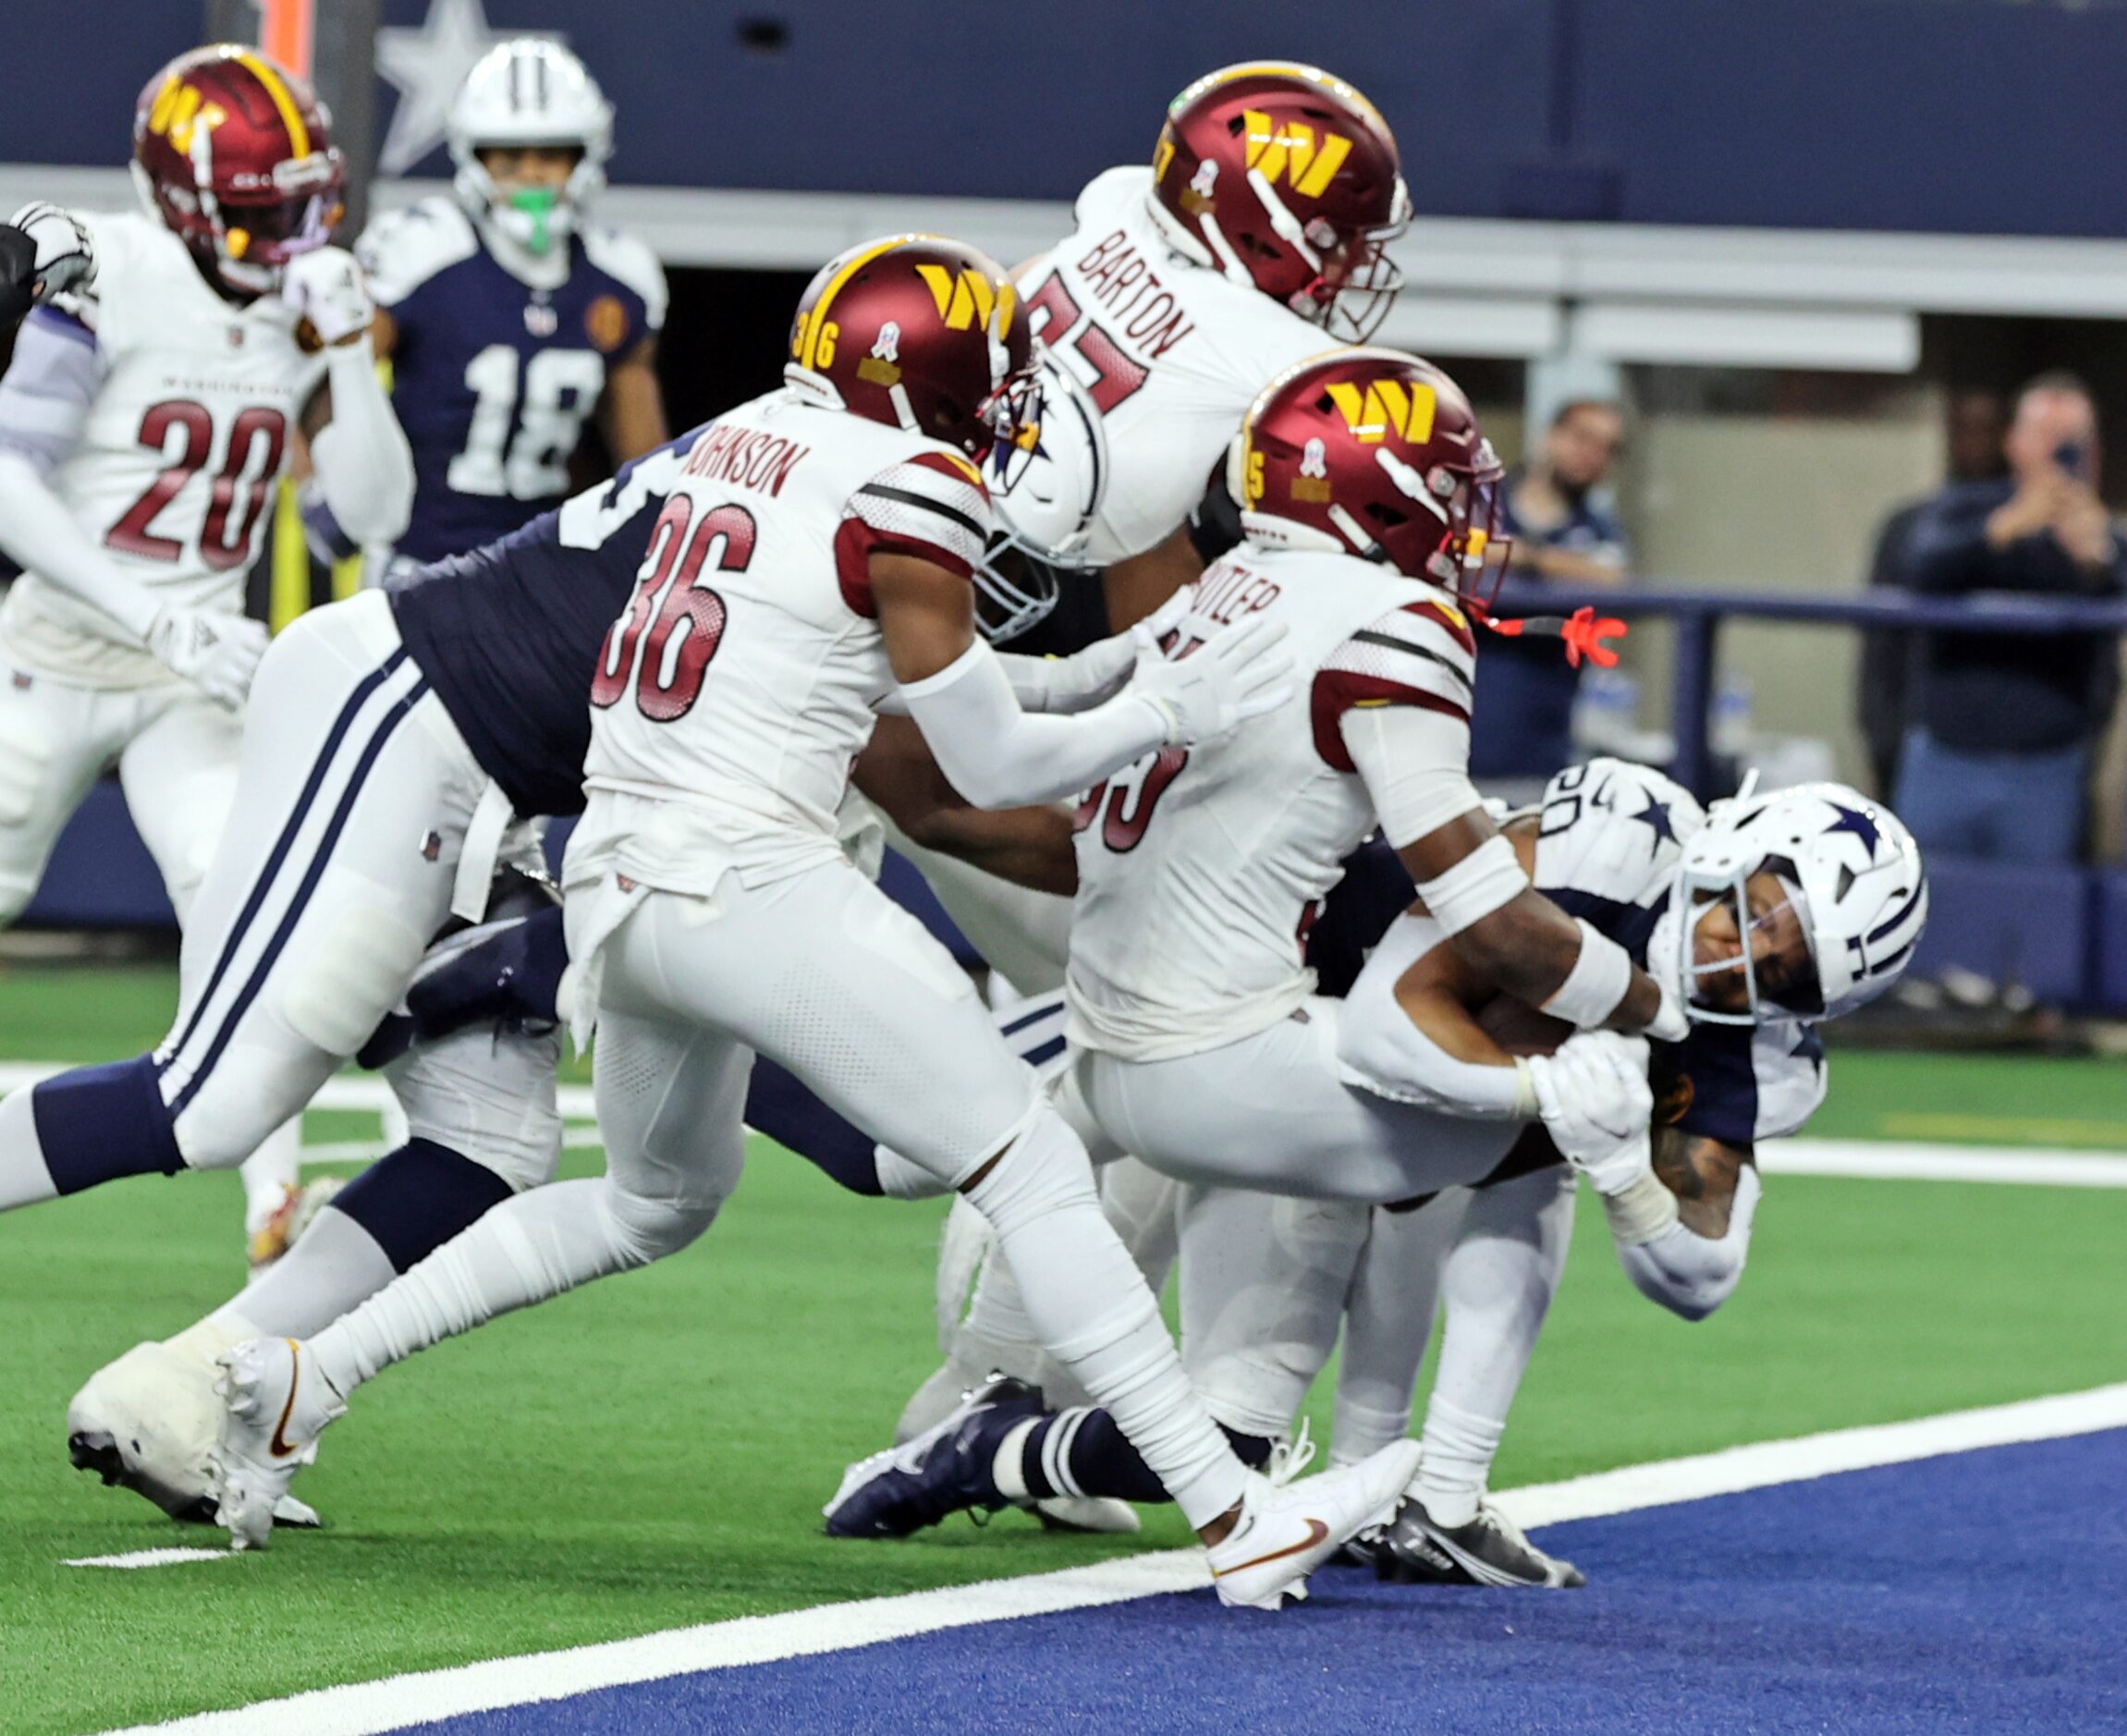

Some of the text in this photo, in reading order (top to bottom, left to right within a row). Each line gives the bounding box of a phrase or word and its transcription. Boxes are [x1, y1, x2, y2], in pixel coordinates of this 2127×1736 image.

[1078, 228, 1196, 360] BARTON
[103, 398, 287, 571] 20
[446, 342, 606, 502] 18
[1324, 378, 1438, 445] W
[590, 492, 757, 724] 36
